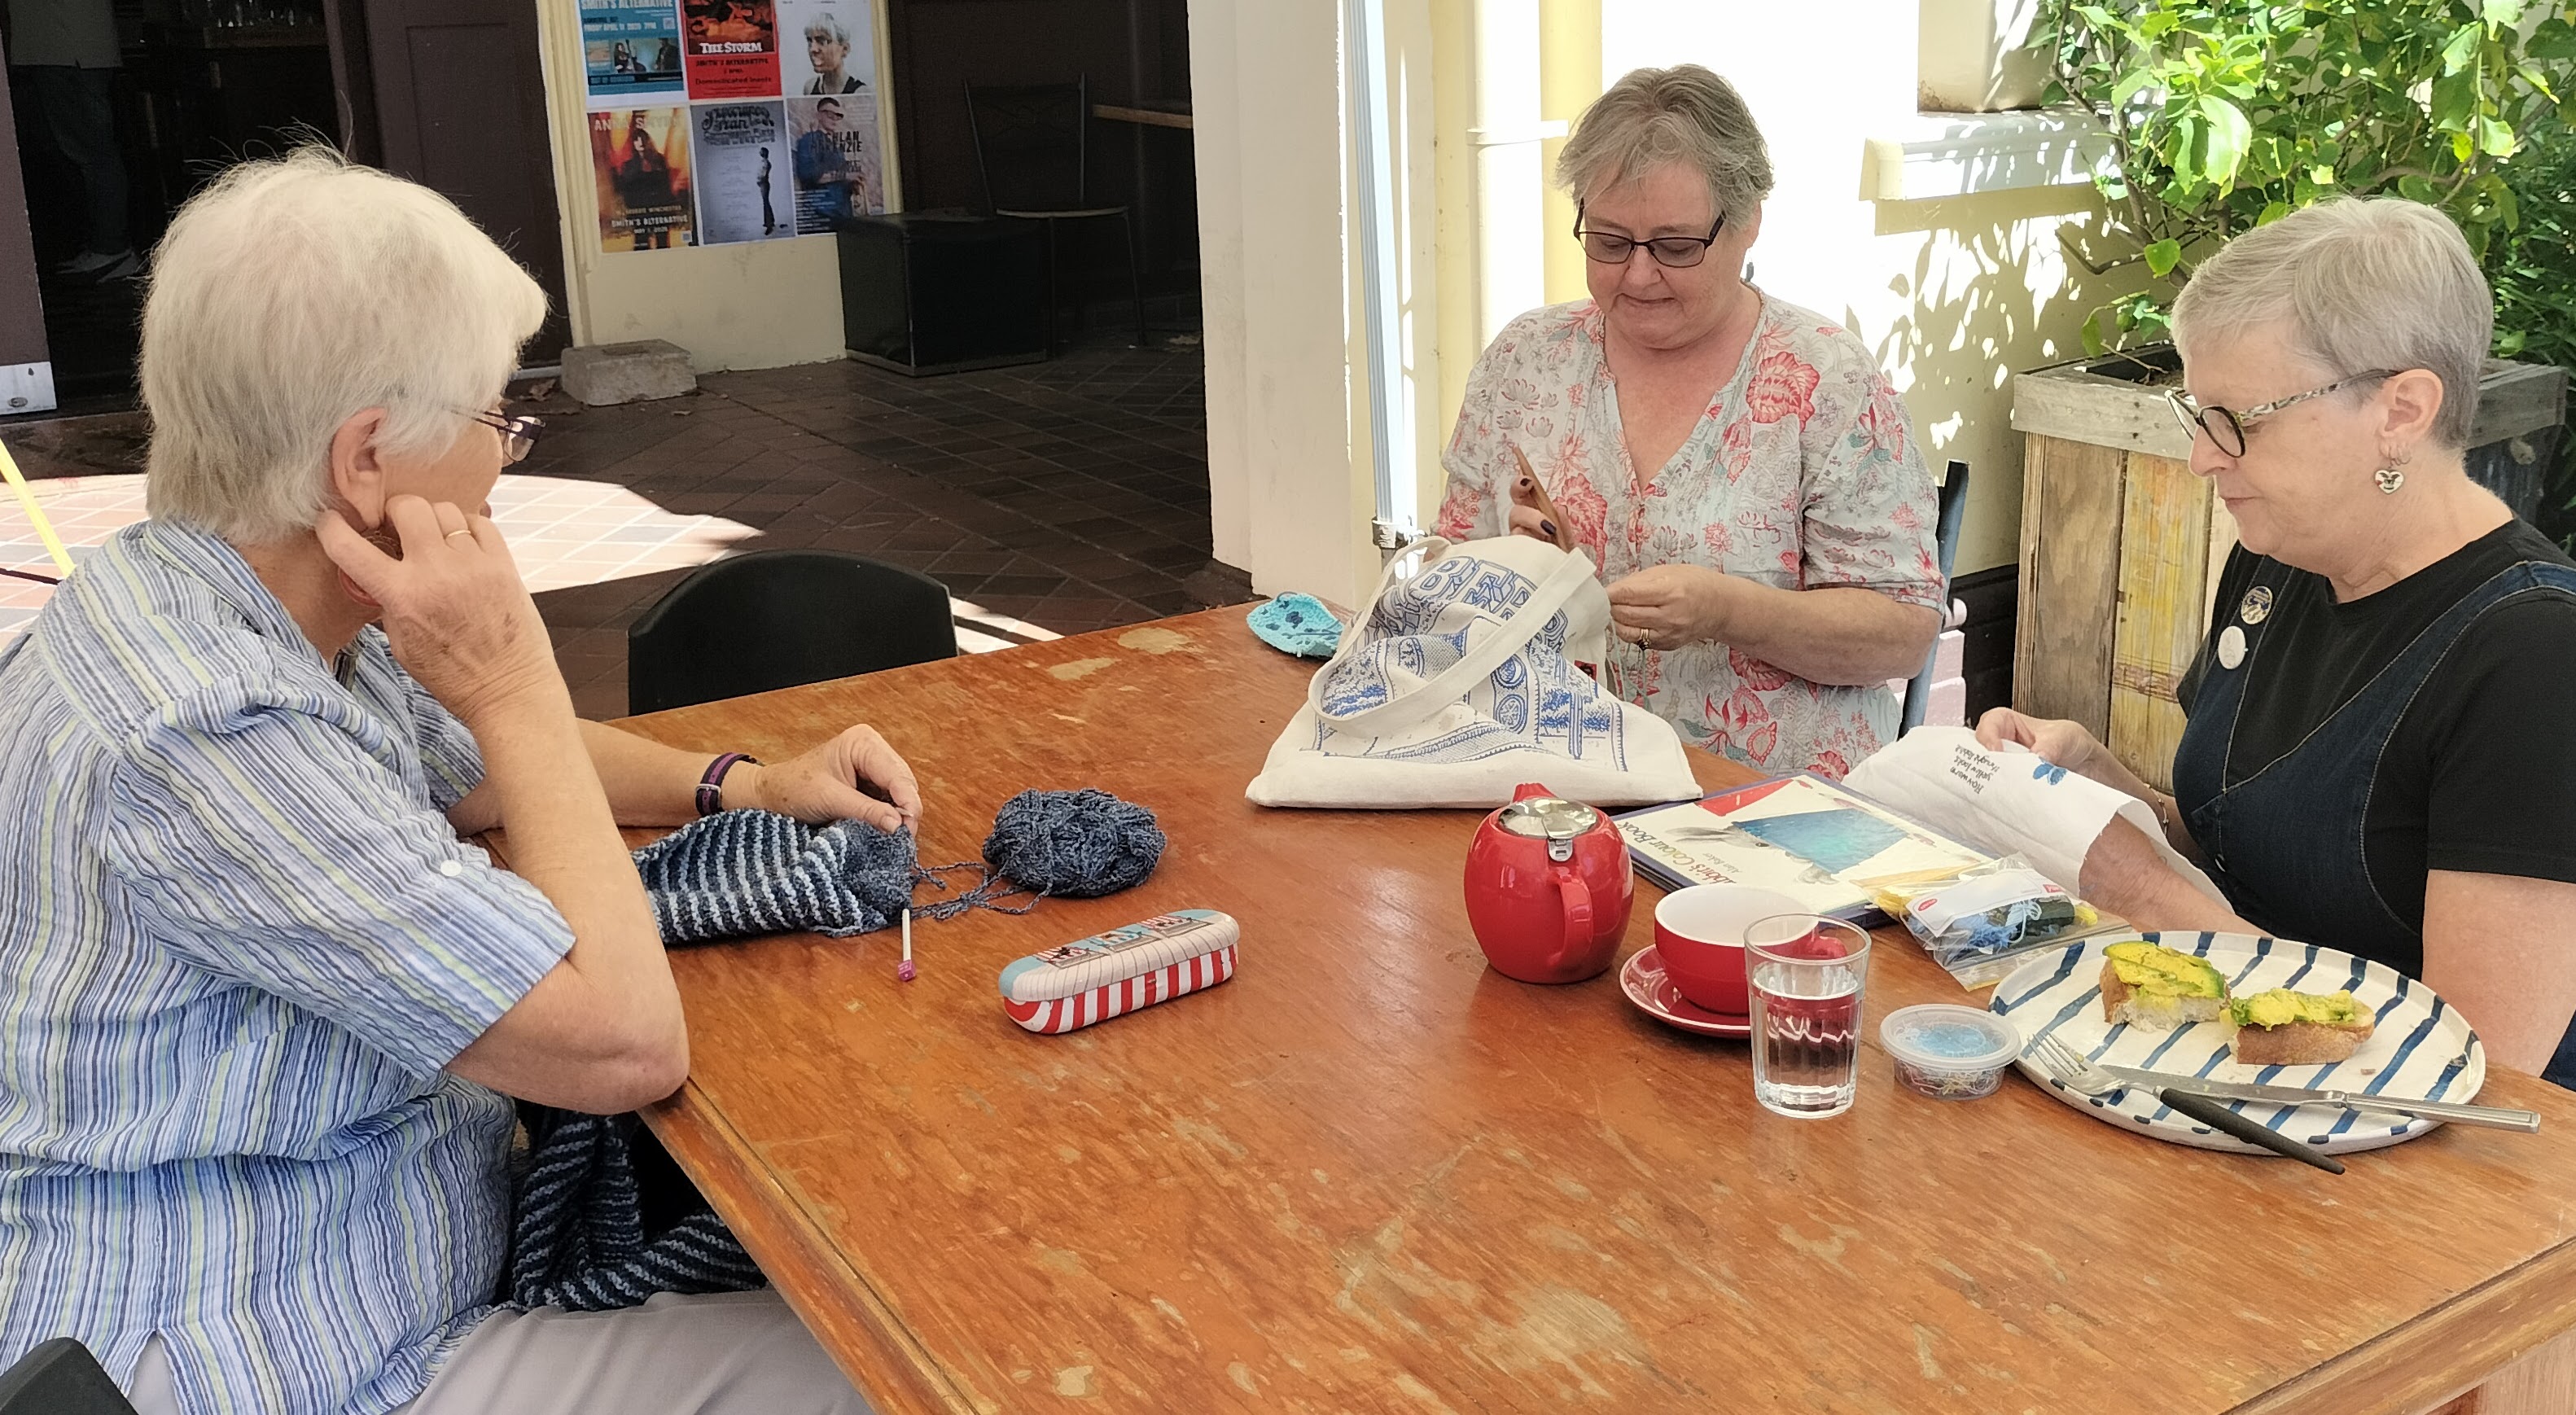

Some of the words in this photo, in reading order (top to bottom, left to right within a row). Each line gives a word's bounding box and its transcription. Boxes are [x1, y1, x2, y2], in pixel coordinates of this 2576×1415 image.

[724, 42, 763, 53] STORM
[1618, 821, 1657, 844] Book
[1648, 840, 1695, 866] Colour
